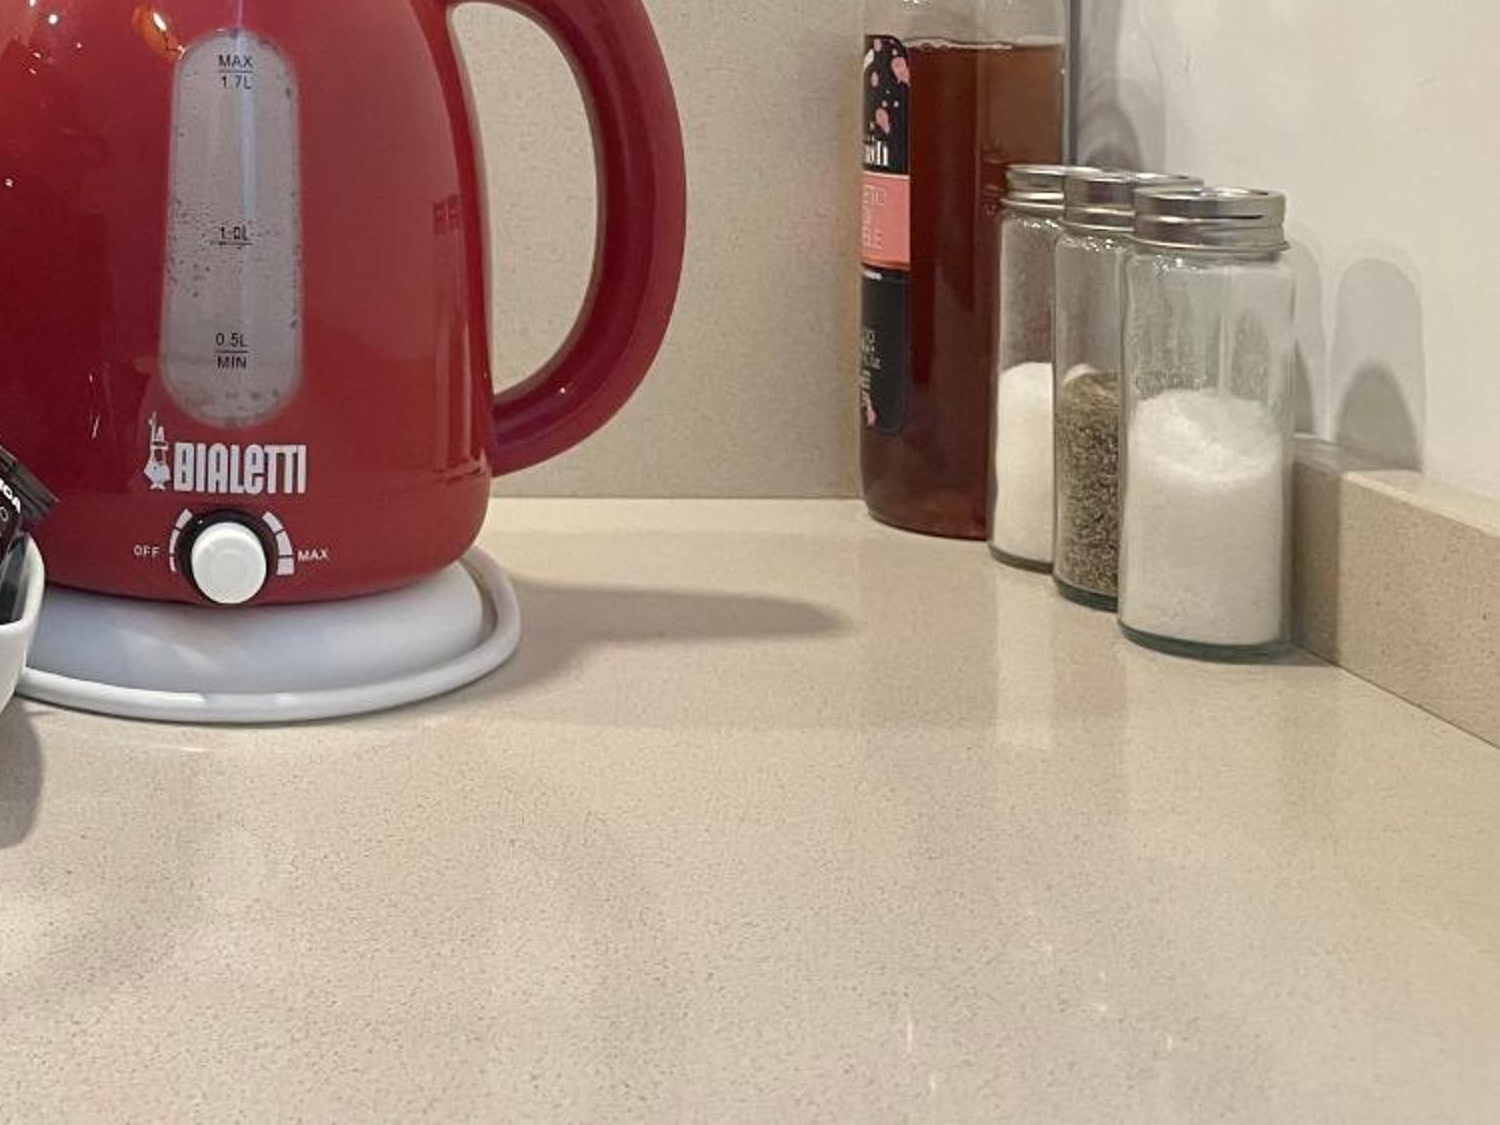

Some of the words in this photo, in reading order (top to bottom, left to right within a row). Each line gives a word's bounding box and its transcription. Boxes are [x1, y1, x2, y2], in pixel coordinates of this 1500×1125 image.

[219, 54, 252, 68] MAX
[217, 356, 247, 369] MIN
[133, 544, 160, 557] OFF
[297, 549, 330, 563] MAX
